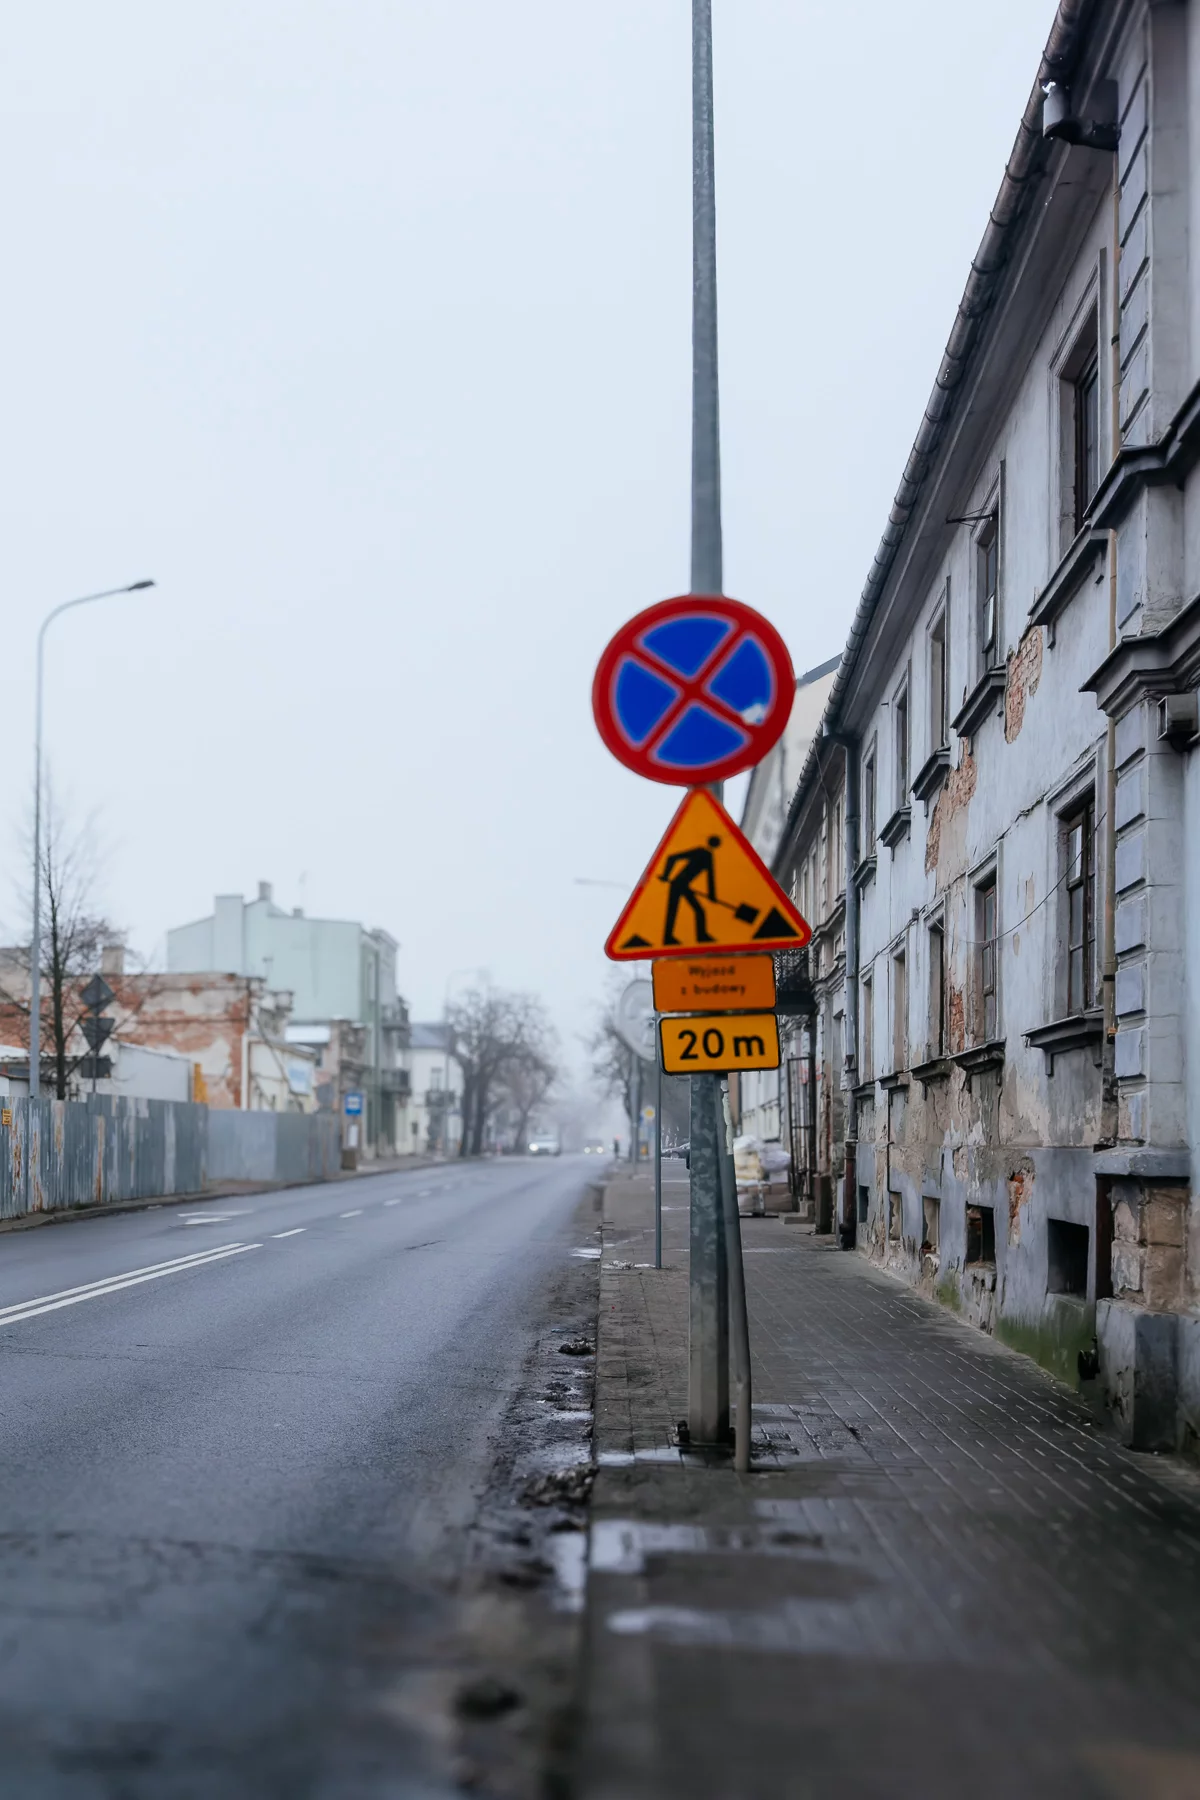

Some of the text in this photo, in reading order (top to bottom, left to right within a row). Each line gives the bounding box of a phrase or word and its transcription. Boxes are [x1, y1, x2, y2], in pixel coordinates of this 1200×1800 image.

[694, 984, 746, 996] budowy
[678, 1028, 765, 1060] 20 m
